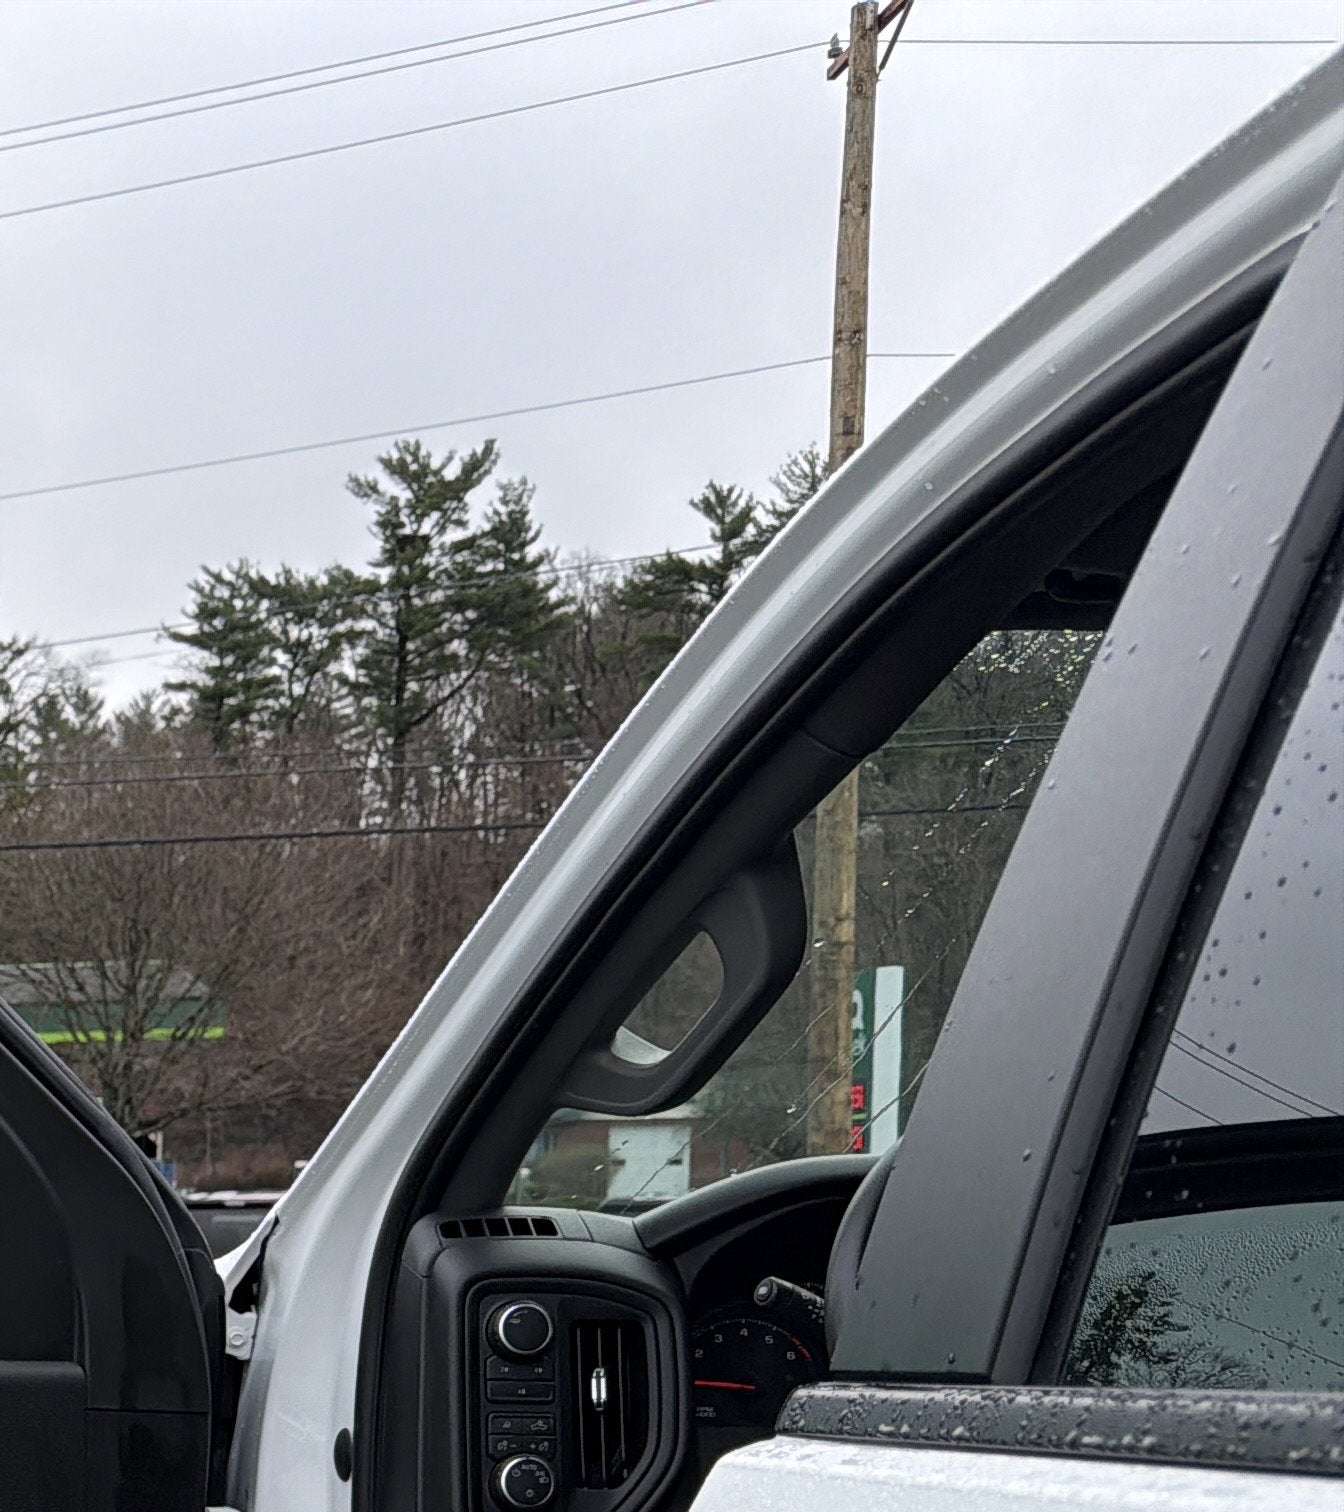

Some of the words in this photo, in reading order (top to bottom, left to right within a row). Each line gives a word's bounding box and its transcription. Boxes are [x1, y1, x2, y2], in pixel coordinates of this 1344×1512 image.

[739, 1327, 749, 1337] 4
[714, 1334, 723, 1343] 3
[764, 1335, 774, 1344] 5
[694, 1348, 704, 1358] 2
[786, 1351, 796, 1361] 6
